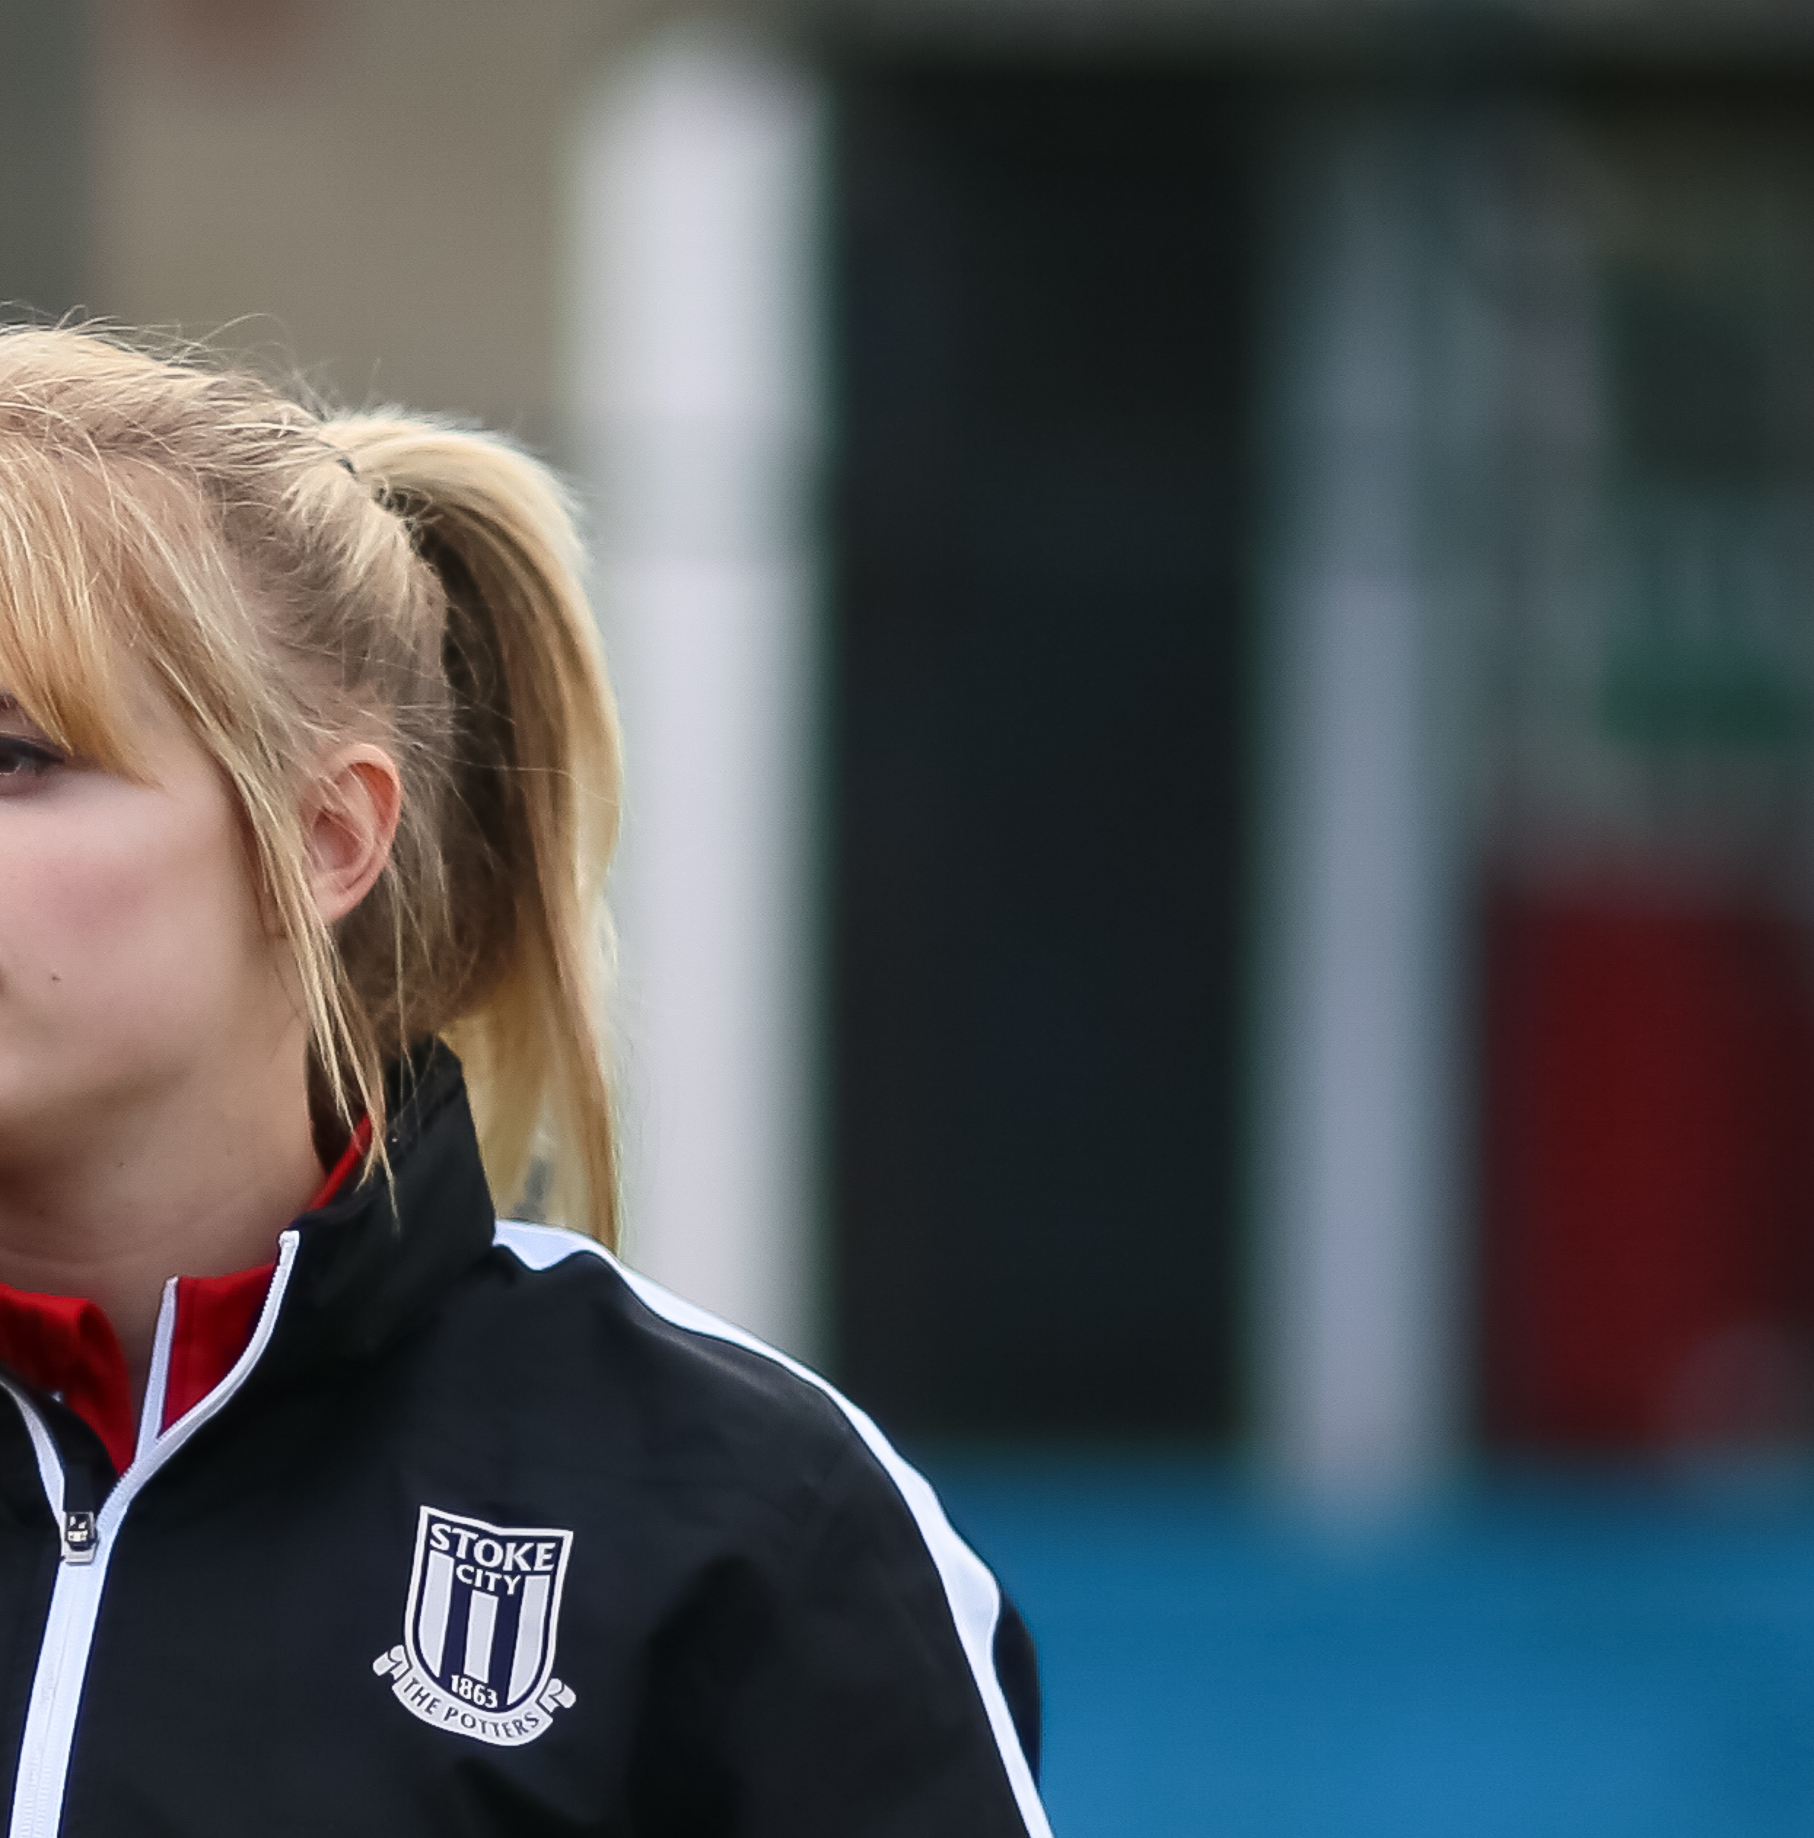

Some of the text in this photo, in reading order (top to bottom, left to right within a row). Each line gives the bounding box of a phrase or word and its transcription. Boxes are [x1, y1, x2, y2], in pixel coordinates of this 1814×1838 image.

[429, 1523, 557, 1572] STOKE
[455, 1564, 522, 1596] CITY
[402, 1676, 540, 1739] THE POTTERS
[450, 1674, 499, 1709] 1863
